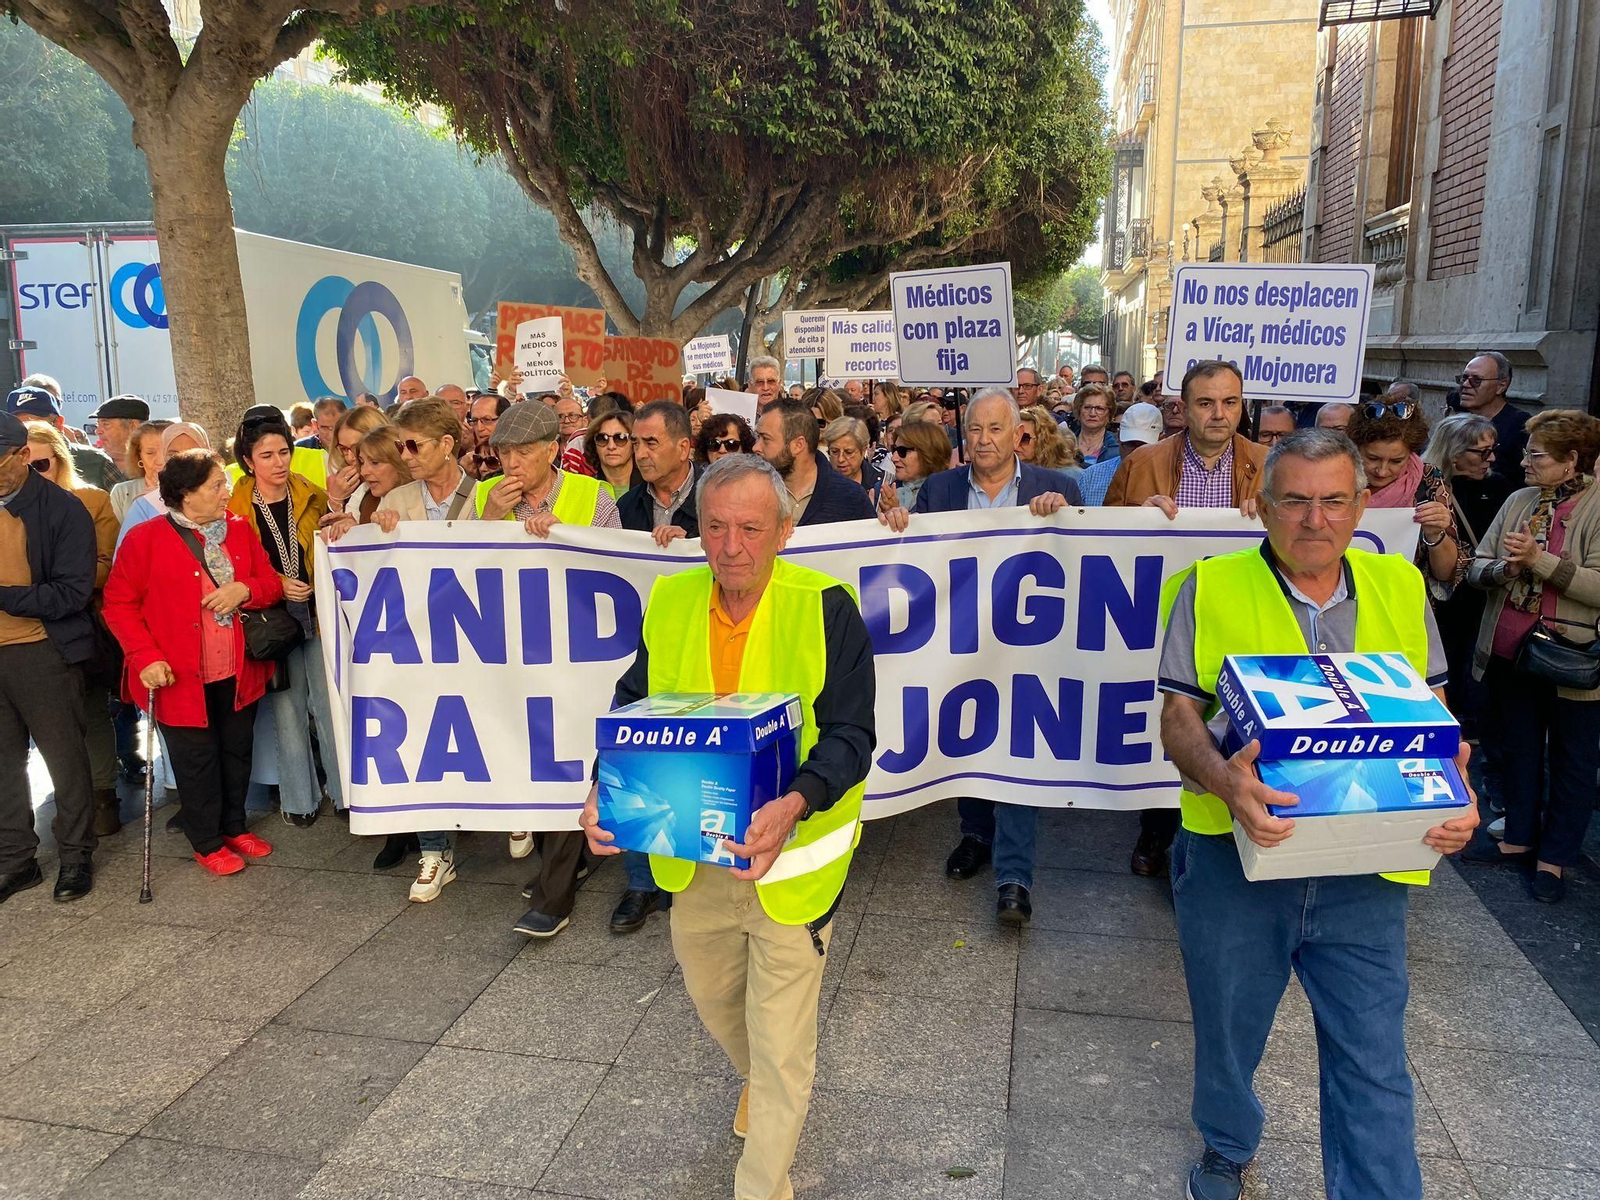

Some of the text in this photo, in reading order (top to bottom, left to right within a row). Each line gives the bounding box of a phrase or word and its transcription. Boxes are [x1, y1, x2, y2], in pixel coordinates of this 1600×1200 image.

[906, 283, 992, 309] Médicos
[1183, 279, 1359, 312] No nos desplacen
[800, 315, 826, 323] Querem
[832, 321, 857, 334] Más
[794, 325, 825, 334] disponibil
[903, 316, 1001, 344] con plaza
[1186, 316, 1346, 349] a Vícar, médicos
[521, 341, 558, 350] MÉDICOS
[690, 341, 721, 351] La Mojonera
[807, 335, 819, 343] cita
[851, 341, 892, 353] menos
[694, 352, 713, 360] merece
[789, 346, 815, 354] atención
[703, 361, 723, 369] médicos
[845, 358, 897, 372] recortes
[936, 348, 969, 376] fija
[1244, 355, 1337, 387] Mojonera
[627, 363, 654, 381] DE
[62, 391, 97, 403] tef.com
[332, 551, 1164, 665] ANID DIGN
[1319, 664, 1351, 699] Double
[1218, 671, 1245, 720] Double
[351, 673, 1160, 784] RA L JONE
[615, 726, 697, 746] Double
[756, 719, 778, 740] Double
[1290, 735, 1394, 754] Double
